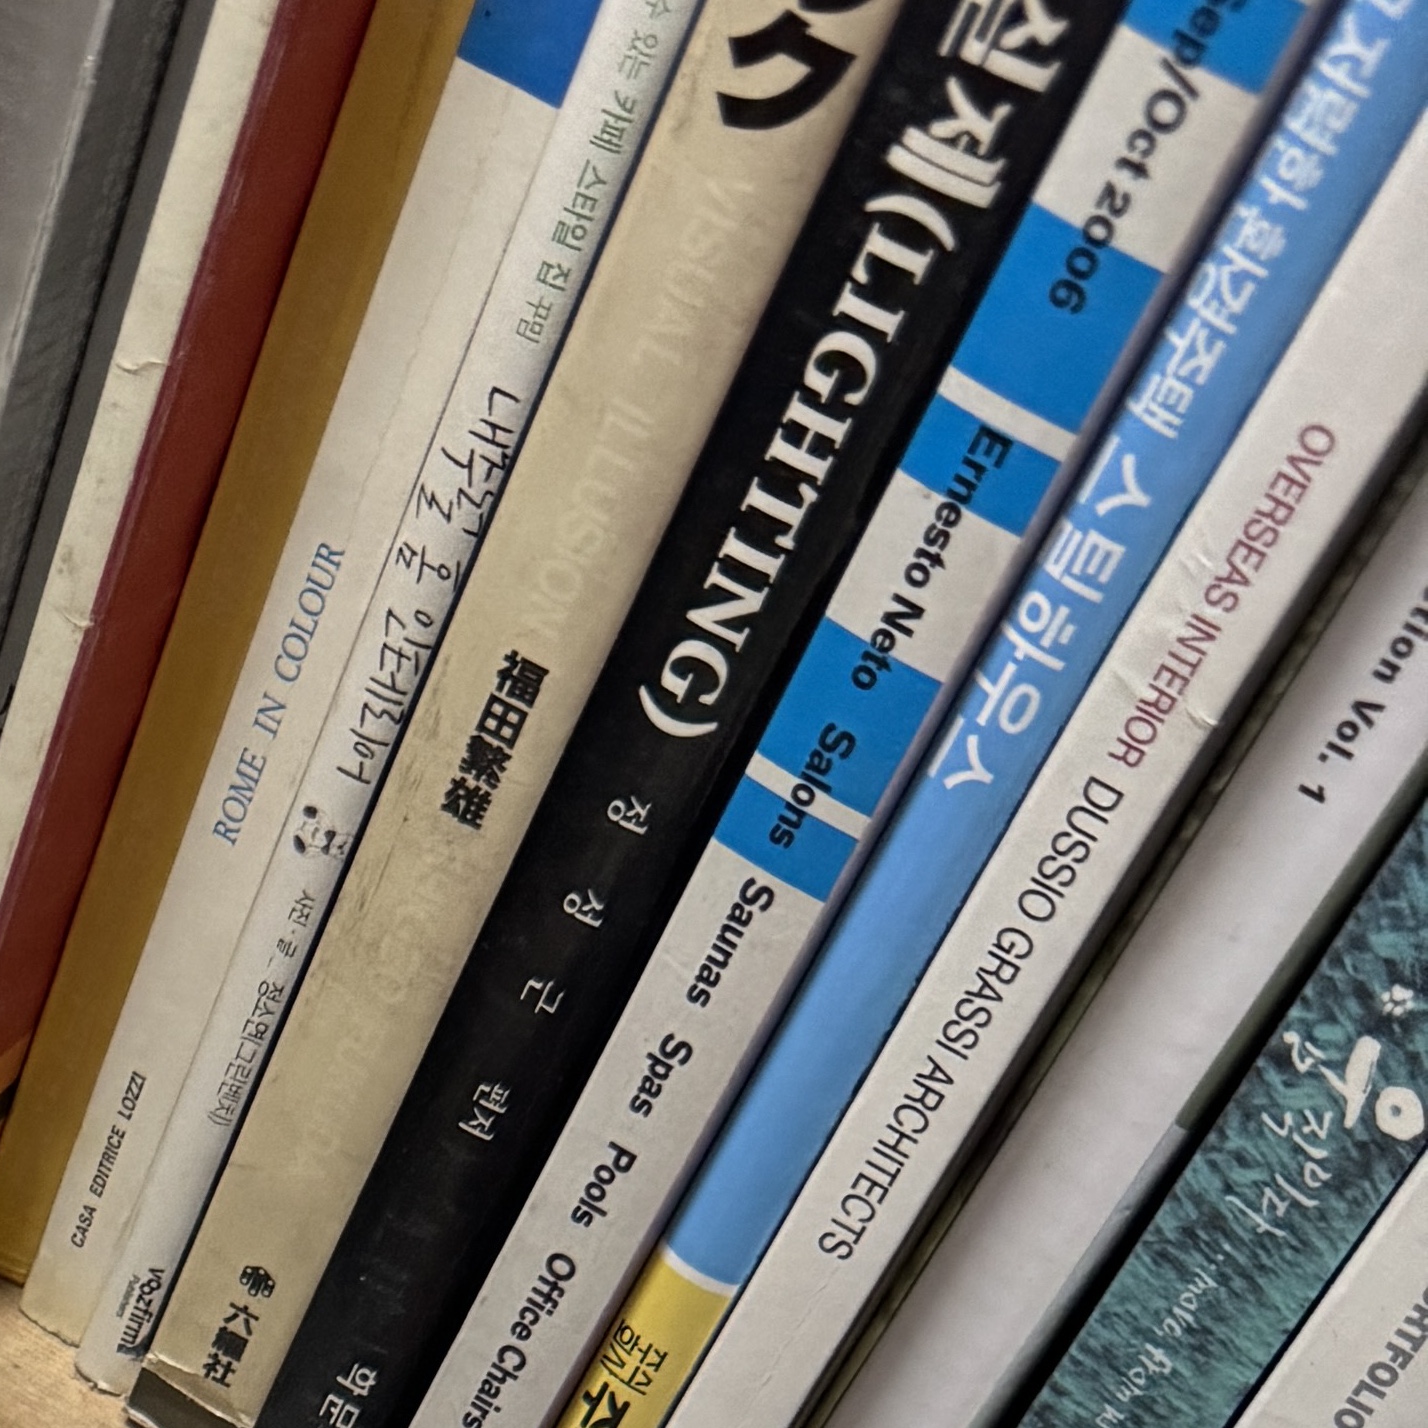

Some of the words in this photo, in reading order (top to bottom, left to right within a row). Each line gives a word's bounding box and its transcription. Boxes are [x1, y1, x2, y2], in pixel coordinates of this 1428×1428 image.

[589, 90, 638, 156] 카페
[551, 158, 609, 253] 스타일
[1048, 178, 1131, 315] 2006
[514, 298, 552, 345] 꾸밈
[536, 259, 572, 292] 집
[903, 424, 1015, 590] Ernesto
[1203, 424, 1337, 613] OVERSEAS
[851, 593, 925, 691] Neto
[929, 435, 1152, 790] 스틸하우스
[212, 746, 266, 847] ROME
[253, 692, 287, 740] IN
[273, 541, 345, 684] COLOUR
[335, 607, 435, 786] 인테리어
[440, 649, 550, 831] 福田繁雄
[1108, 613, 1221, 768] INTERIOR
[1318, 700, 1386, 764] Vol.
[769, 723, 857, 850] Salons
[1298, 781, 1328, 805] 1
[1019, 776, 1125, 923] DUSSIO
[277, 938, 299, 959] 글
[288, 890, 317, 927] 사진
[687, 876, 776, 1008] Saunas
[936, 926, 1035, 1061] GRASSI
[458, 1080, 513, 1142] 편저
[628, 1032, 694, 1118] Spas
[70, 1205, 97, 1249] CASA
[90, 1124, 126, 1199] EDITRICE
[119, 1071, 148, 1121] LOZZI
[571, 1141, 638, 1228] Pools
[818, 1055, 955, 1261] ARCHITECTS
[510, 1252, 576, 1342] Office
[1115, 1343, 1171, 1404] from
